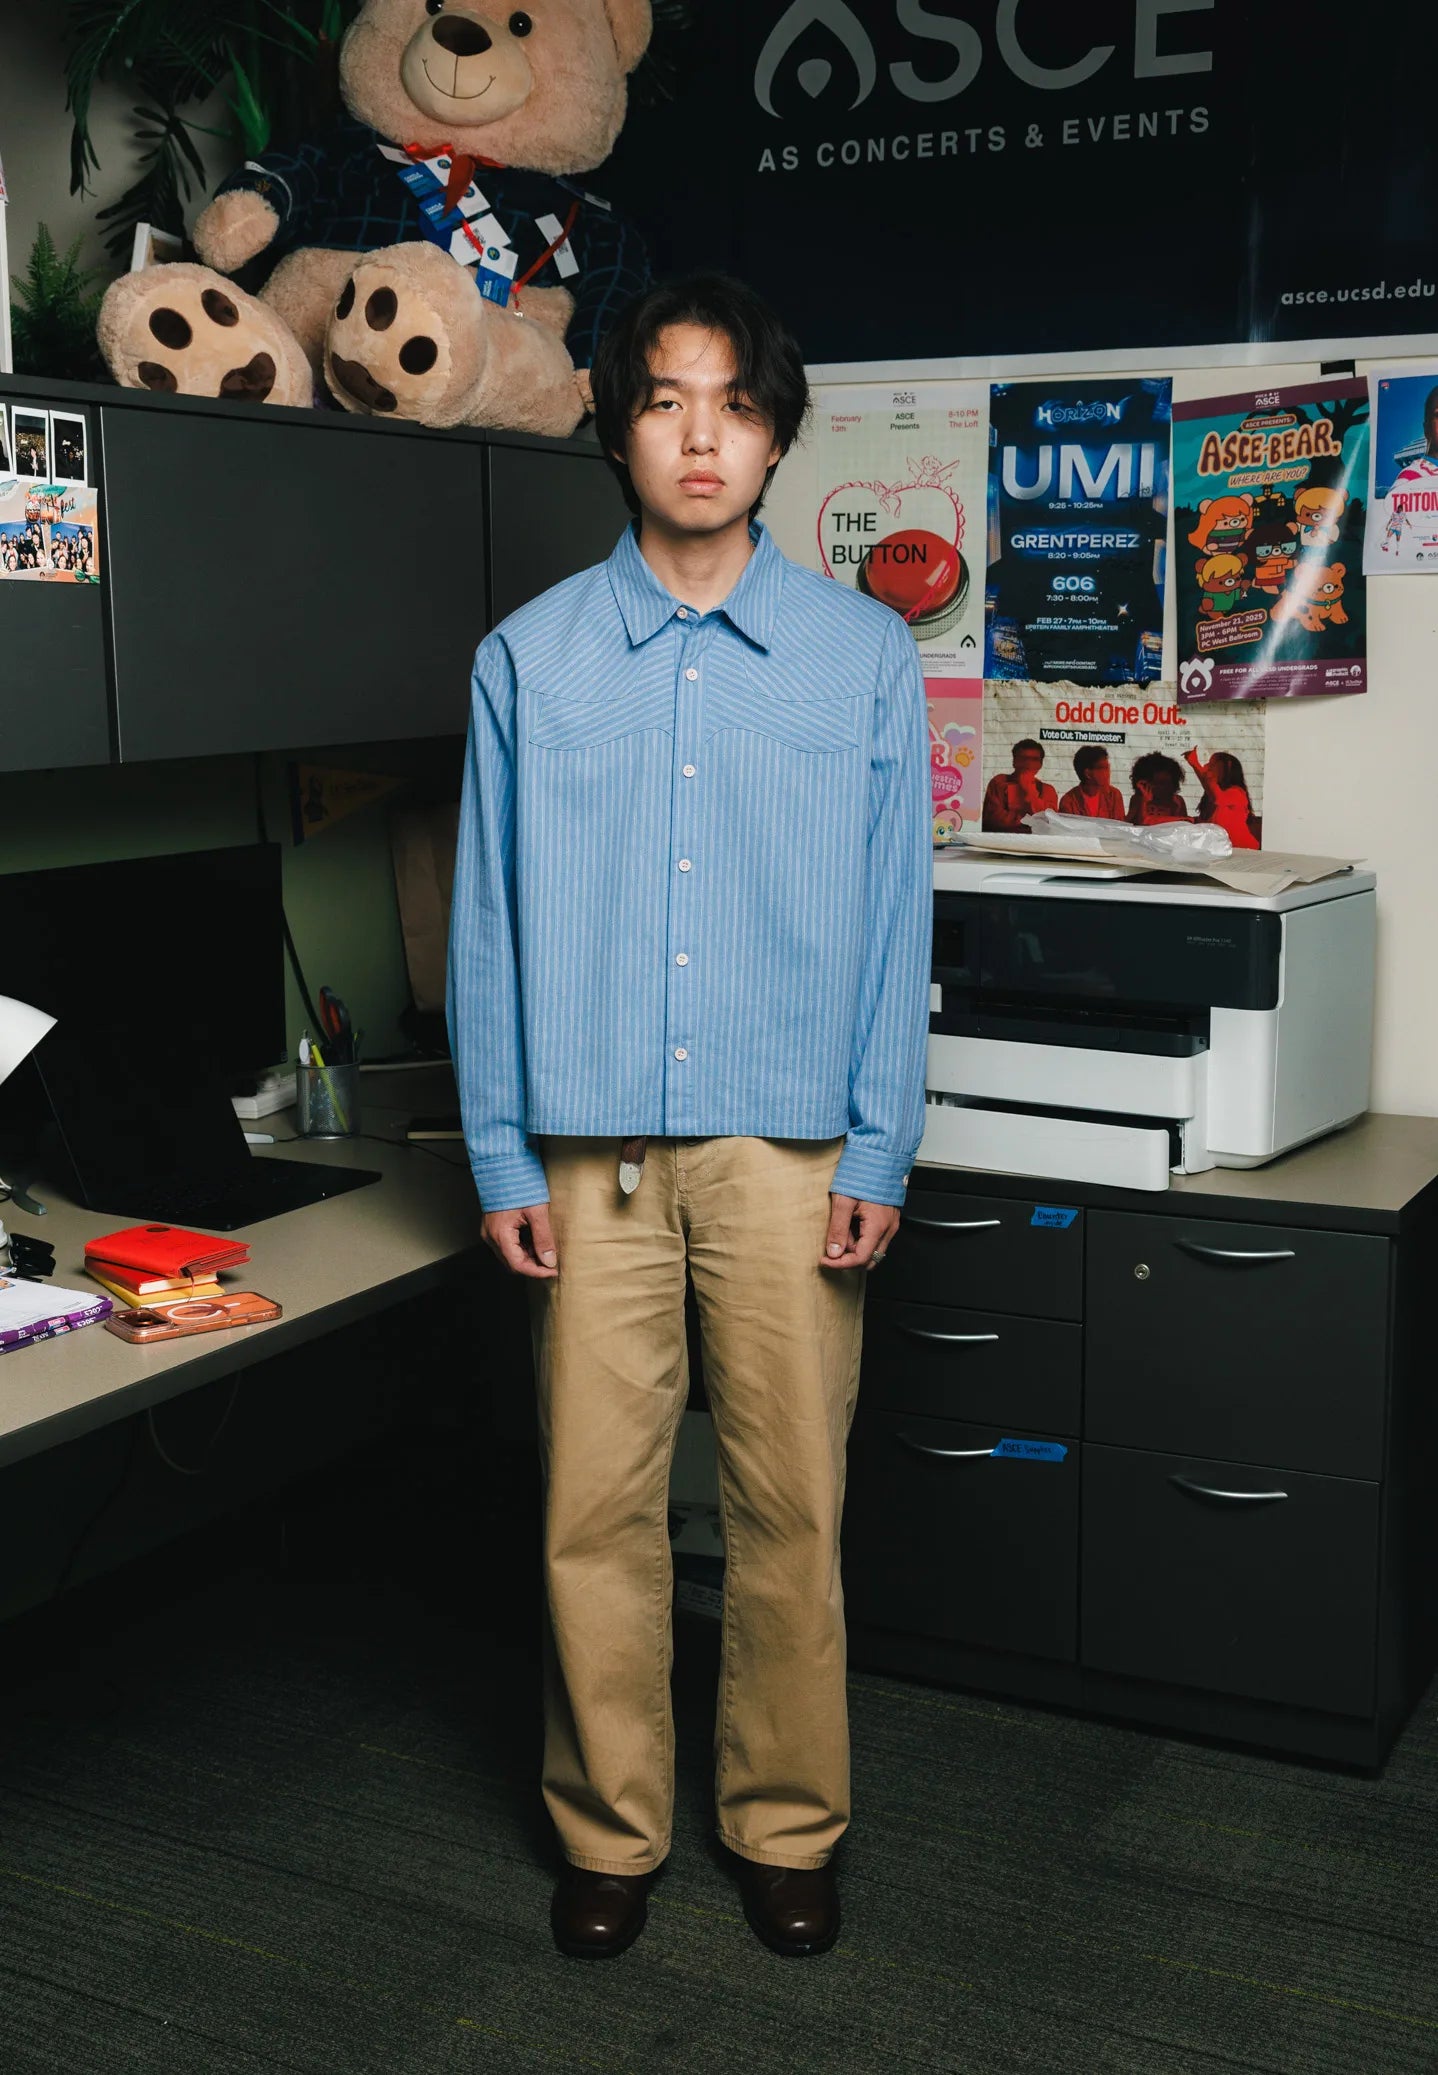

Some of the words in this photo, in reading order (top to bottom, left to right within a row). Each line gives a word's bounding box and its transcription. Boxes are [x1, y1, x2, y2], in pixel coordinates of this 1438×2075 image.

[758, 147, 801, 173] AS
[816, 127, 1006, 168] CONCERTS
[1025, 124, 1045, 148] &
[1062, 106, 1211, 145] EVENTS
[1281, 278, 1437, 307] asce.ucsd.edu
[831, 415, 862, 424] February
[895, 412, 915, 420] ASCE
[966, 409, 979, 417] PM
[890, 423, 920, 431] Presents
[949, 421, 963, 429] The
[964, 420, 979, 428] Loft
[1002, 443, 1155, 500] UMI
[1230, 473, 1262, 486] WHERE
[1264, 471, 1282, 482] ARE
[1285, 467, 1308, 480] YOU?
[832, 512, 877, 532] THE
[1010, 533, 1141, 549] GRENTPEREZ
[832, 543, 928, 564] BUTTON
[1052, 576, 1095, 591] 606
[1199, 620, 1231, 633] November
[1245, 613, 1263, 622] 2025
[1221, 627, 1237, 635] 6PM
[1201, 640, 1211, 648] PC
[1212, 637, 1228, 645] West
[1277, 664, 1318, 672] UNDERGRADS
[1055, 701, 1095, 724] Odd
[1099, 702, 1139, 724] One
[1143, 702, 1187, 726] Out.
[1042, 730, 1060, 739] Vote
[1060, 731, 1074, 740] Out
[1074, 731, 1088, 740] The
[1088, 732, 1123, 743] Imposter.
